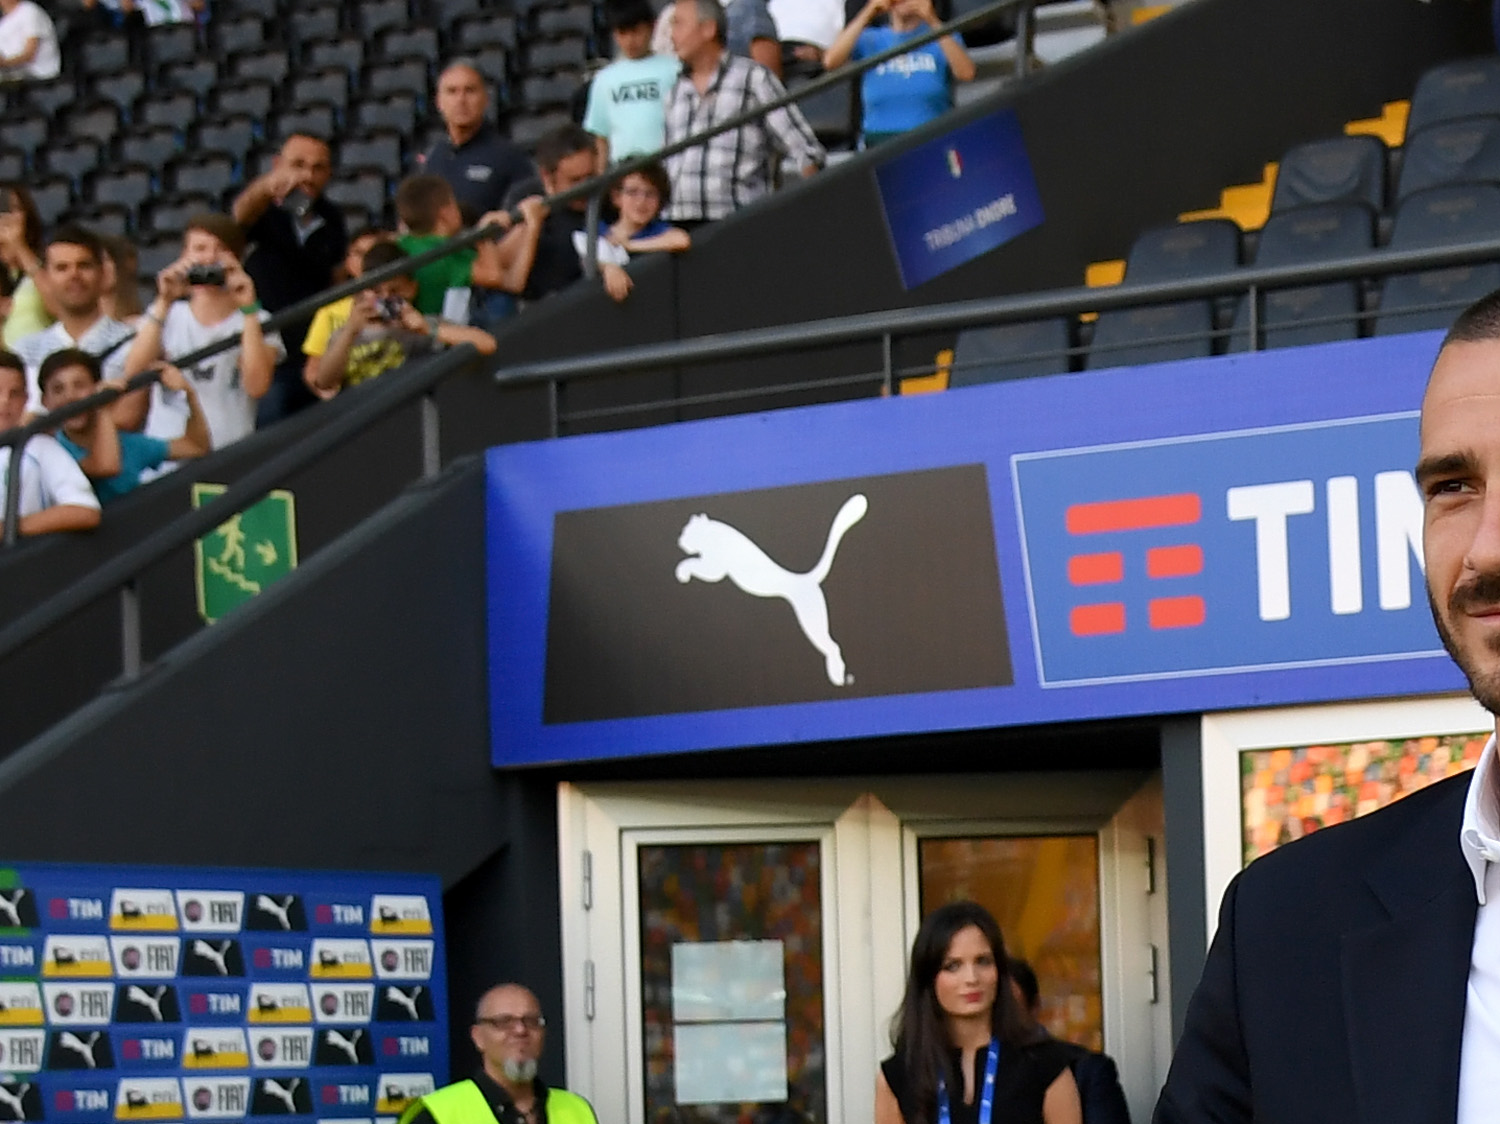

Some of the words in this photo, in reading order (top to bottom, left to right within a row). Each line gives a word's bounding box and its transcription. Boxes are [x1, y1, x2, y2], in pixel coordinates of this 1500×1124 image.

[611, 81, 660, 104] VANS
[68, 898, 103, 919] TIM
[211, 902, 238, 923] FIAT
[332, 904, 363, 924] TIM
[2, 946, 34, 965] TIM
[147, 945, 174, 970] FIAT
[271, 948, 303, 968] TIM
[404, 947, 429, 972] FIAT
[80, 991, 109, 1017] FIAT
[208, 993, 240, 1013] TIM
[343, 991, 369, 1016] FIAT
[9, 1037, 39, 1064] FIAT
[140, 1039, 174, 1059] TIM
[282, 1035, 308, 1061] FIAT
[399, 1037, 430, 1055] TIM
[73, 1090, 109, 1110] TIM
[217, 1085, 244, 1111] FIAT
[339, 1085, 369, 1103] TIM
